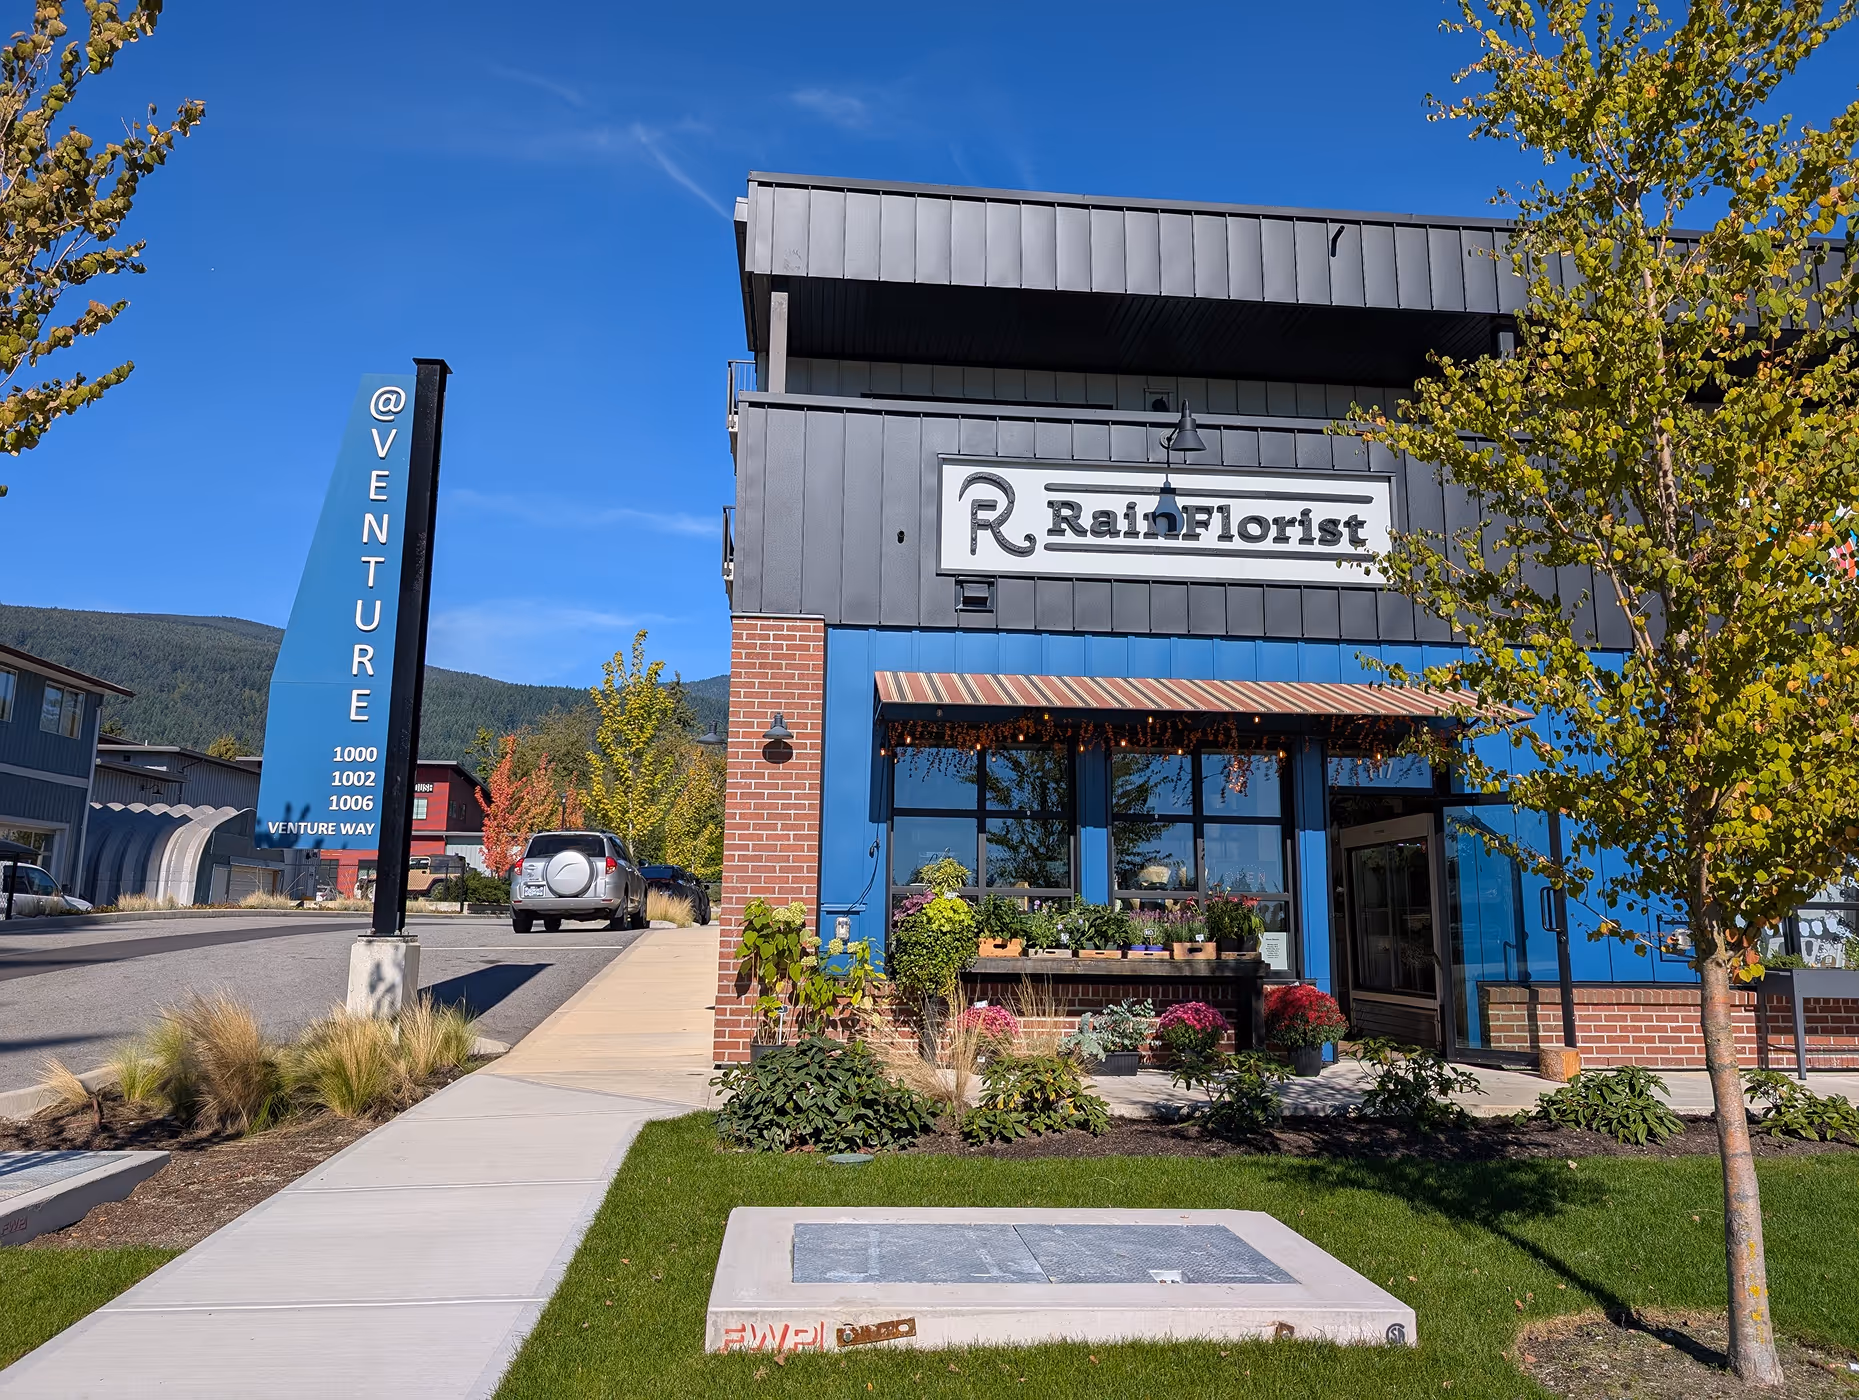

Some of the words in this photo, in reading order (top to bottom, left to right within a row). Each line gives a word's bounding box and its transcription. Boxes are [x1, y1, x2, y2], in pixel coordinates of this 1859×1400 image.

[1047, 499, 1369, 547] RainFlorist
[333, 746, 378, 762] 1000
[331, 770, 376, 787] 1002
[328, 795, 374, 811] 1006
[267, 821, 337, 835] VENTURE
[340, 822, 376, 836] WAY
